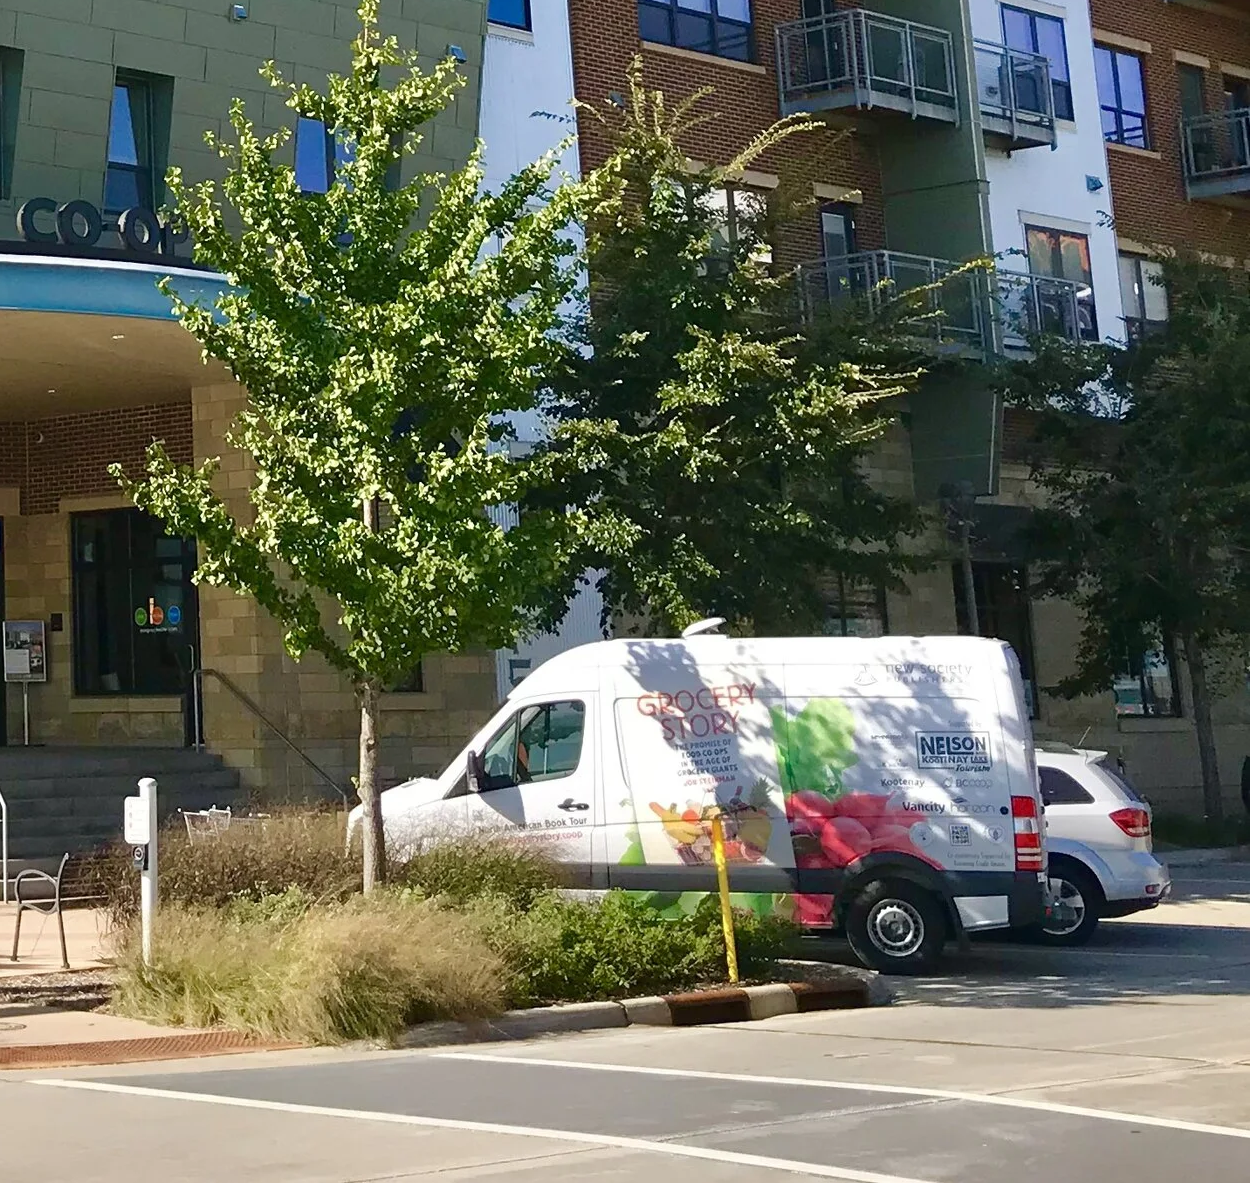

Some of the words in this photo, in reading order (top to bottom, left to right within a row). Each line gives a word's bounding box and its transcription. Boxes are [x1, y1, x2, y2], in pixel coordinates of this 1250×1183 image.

[16, 197, 189, 256] CO-OP
[637, 682, 756, 717] GROCERY
[661, 710, 739, 741] STORY
[690, 739, 720, 749] PROMISE
[920, 736, 986, 755] NELSON
[711, 763, 738, 773] GIANTS
[902, 801, 945, 814] Vancity
[544, 818, 566, 829] Book
[569, 817, 588, 826] Tour
